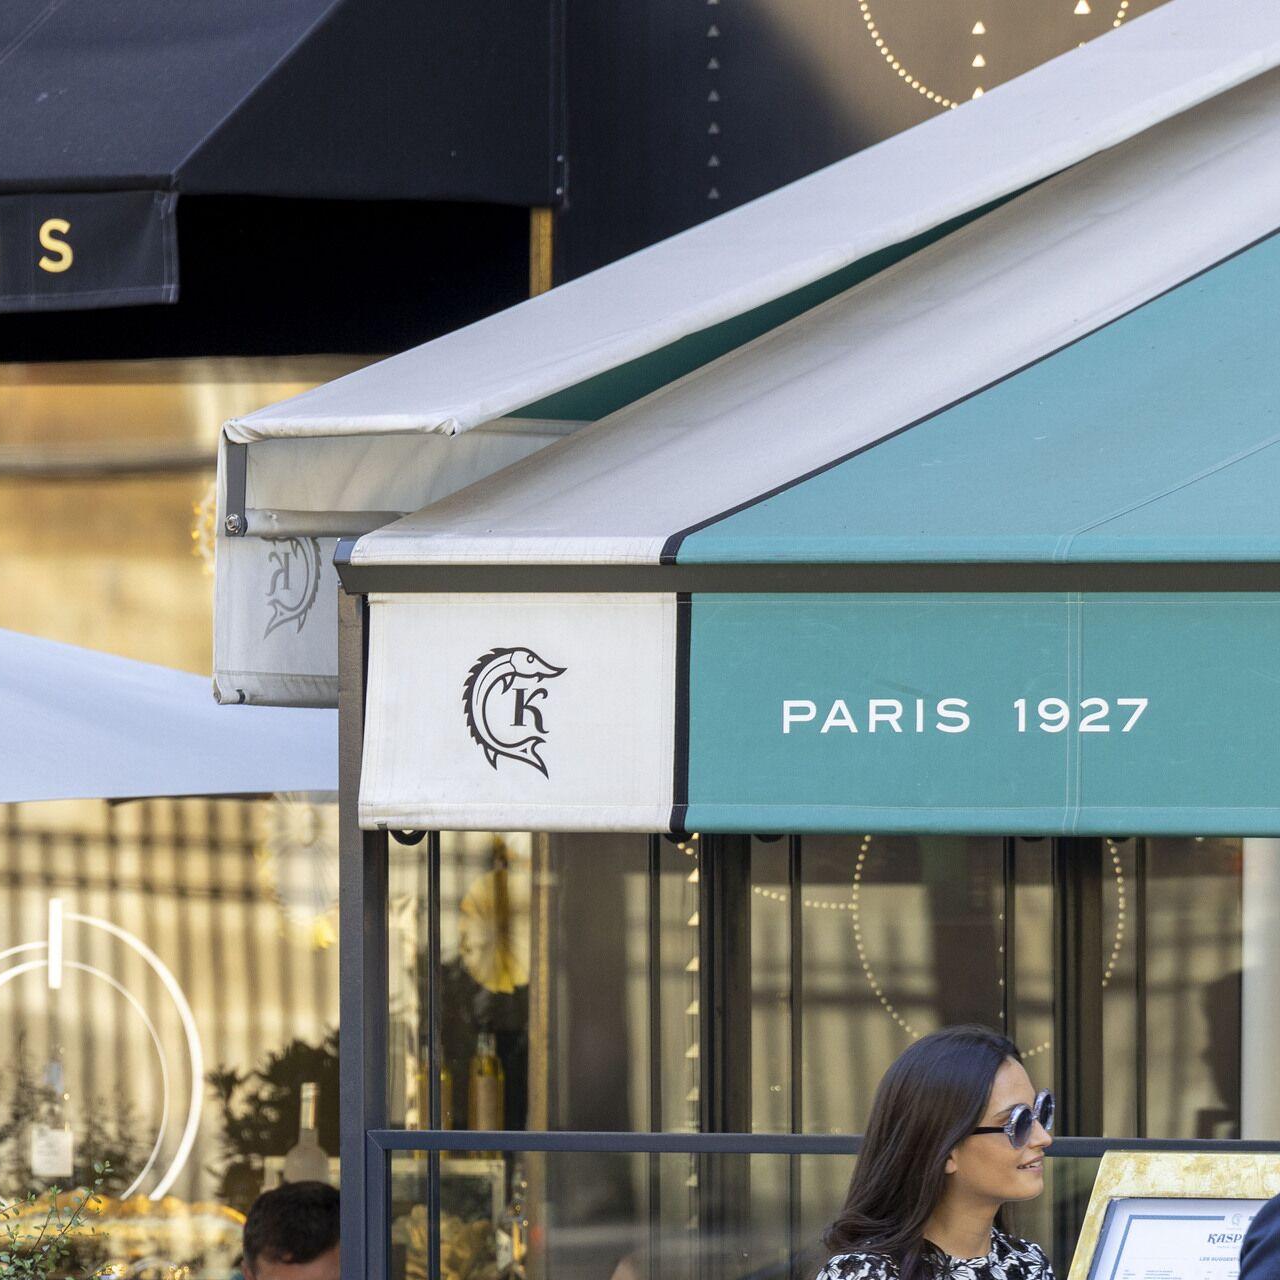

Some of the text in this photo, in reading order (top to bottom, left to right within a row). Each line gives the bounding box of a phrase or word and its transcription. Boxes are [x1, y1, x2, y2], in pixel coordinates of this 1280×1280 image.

[783, 697, 1148, 734] PARIS 1927
[1207, 1233, 1244, 1245] KASP
